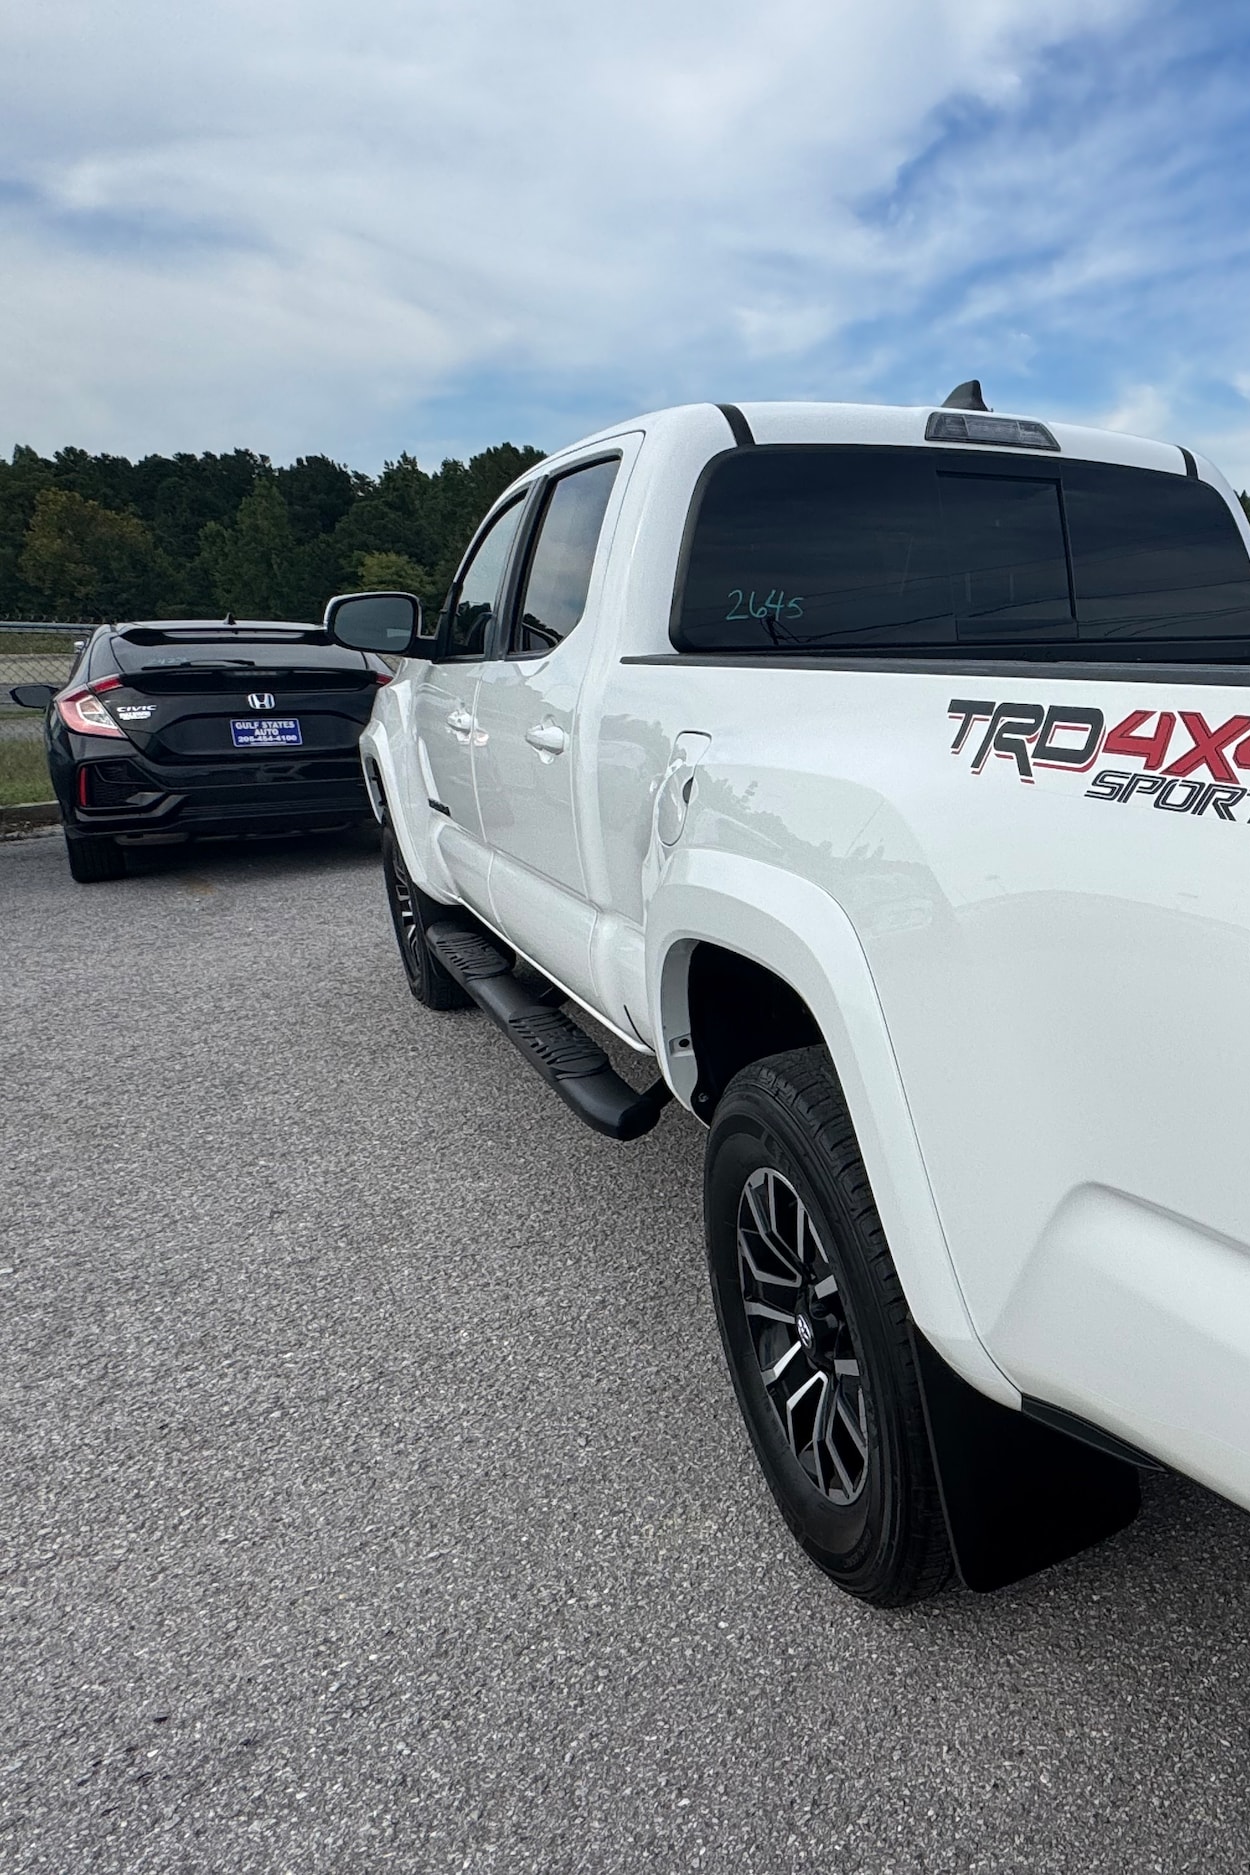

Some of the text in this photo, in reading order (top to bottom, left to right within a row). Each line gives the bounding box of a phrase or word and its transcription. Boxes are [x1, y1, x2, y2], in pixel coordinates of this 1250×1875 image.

[726, 589, 804, 621] 2645
[254, 728, 279, 736] AUTO
[238, 735, 298, 743] 205-454-4100
